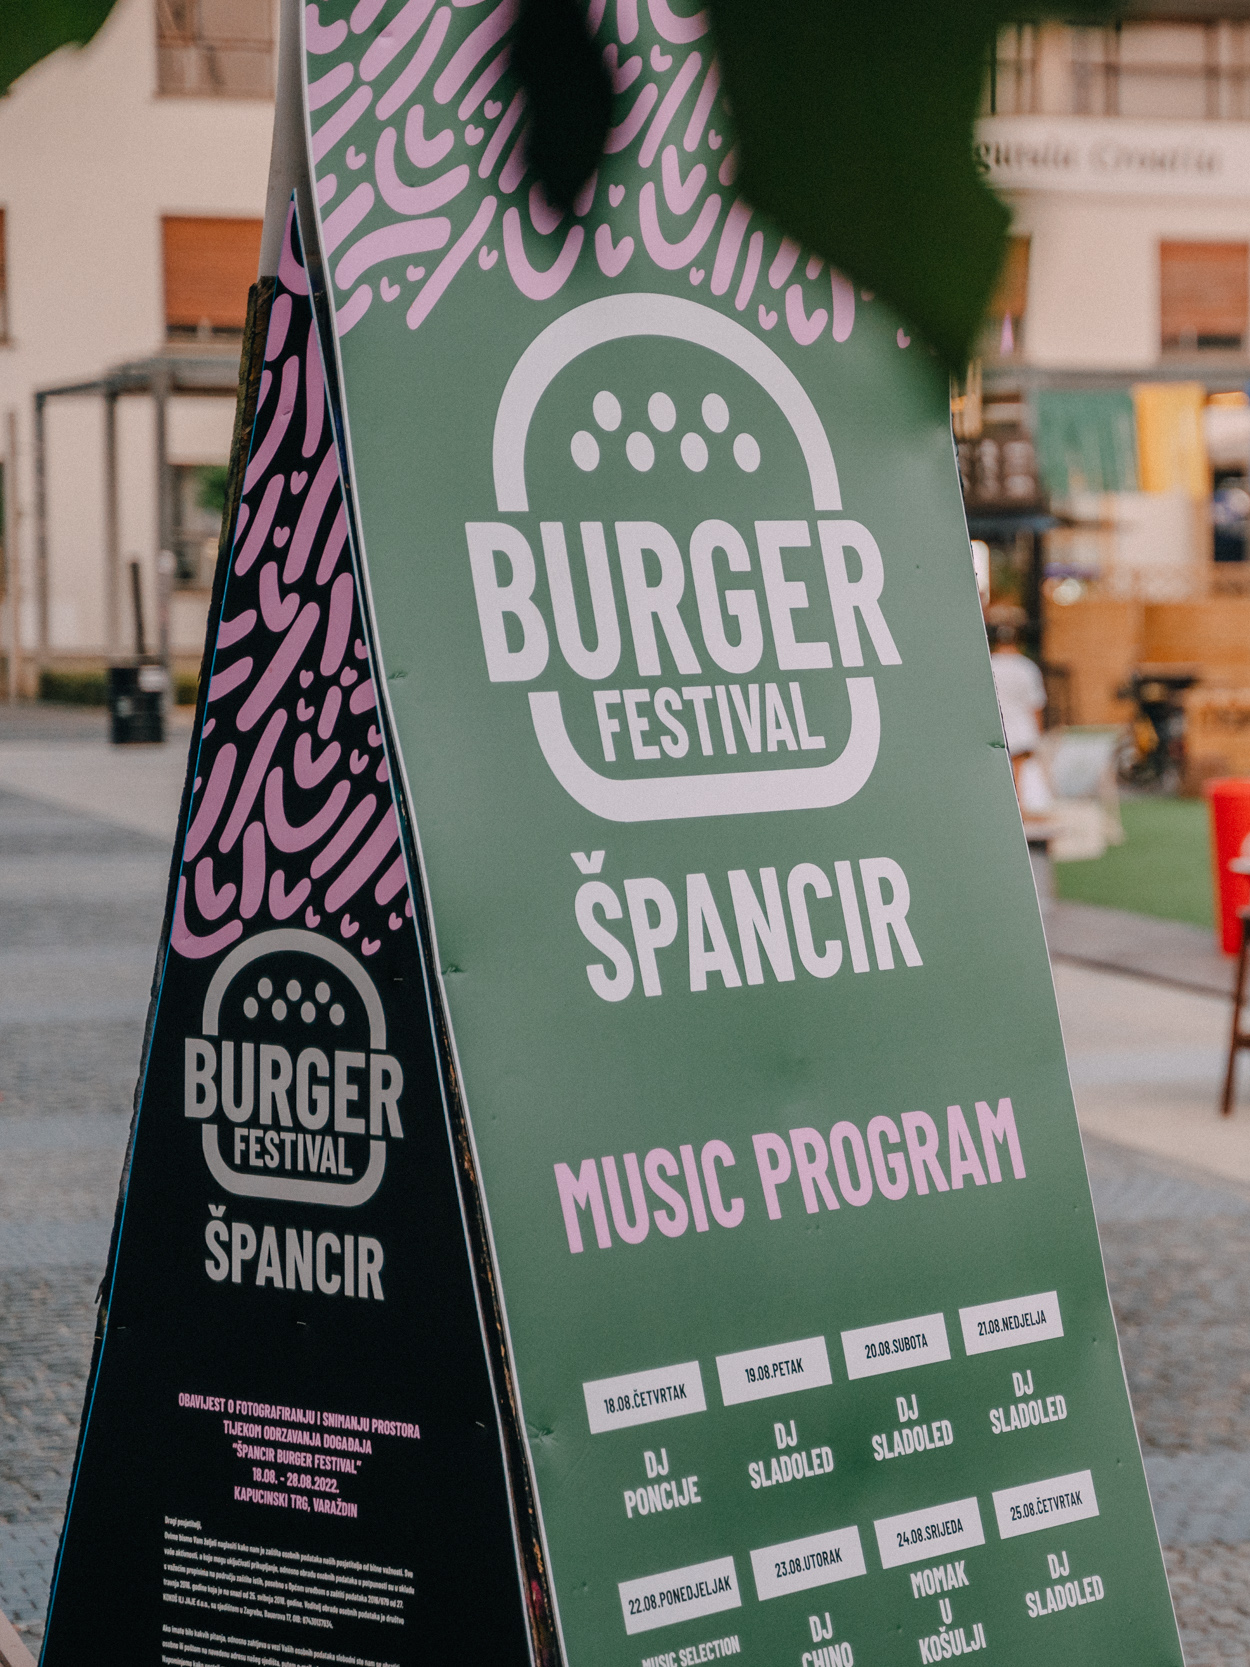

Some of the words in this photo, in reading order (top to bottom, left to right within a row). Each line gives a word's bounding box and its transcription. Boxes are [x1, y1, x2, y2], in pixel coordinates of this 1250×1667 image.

[465, 518, 903, 682] BURGER
[593, 681, 827, 762] FESTIVAL
[570, 850, 924, 1002] ŠPANCIR
[184, 1037, 404, 1138] BURGER
[234, 1126, 353, 1176] FESTIVAL
[553, 1139, 746, 1254] MUSIC
[751, 1096, 1027, 1221] PROGRAM
[204, 1203, 385, 1300] ŠPANCIR
[977, 1310, 1047, 1337] 21.08.NEDJELJA
[864, 1333, 929, 1359] 20.08.SUBOTA
[744, 1357, 804, 1383] 19.08.PETAK
[1011, 1369, 1034, 1398] DJ
[603, 1383, 687, 1414] 18.08.ČETVRTAK
[895, 1393, 919, 1423] DJ
[989, 1394, 1068, 1435] SLADOLED
[178, 1392, 226, 1413] OBAVIJEST
[227, 1399, 234, 1414] O
[236, 1400, 315, 1425] FOTOGRAFIRANJU
[317, 1411, 321, 1425] I
[322, 1411, 370, 1432] SNIMANJU
[371, 1418, 420, 1439] PROSTORA
[223, 1420, 262, 1439] TIJEKOM
[773, 1419, 798, 1450] DJ
[871, 1419, 954, 1461] SLADOLED
[276, 1448, 312, 1468] BURGER
[643, 1447, 669, 1479] DJ
[748, 1446, 834, 1490] SLADOLED
[252, 1466, 278, 1484] 18.08.
[286, 1472, 339, 1493] 28.08.2022.
[234, 1485, 288, 1508] KAPUCINSKI
[290, 1493, 311, 1512] TRG,
[312, 1497, 358, 1518] VARAŽDIN
[623, 1476, 702, 1519] PONCIJE
[1010, 1491, 1083, 1521] 25.08.ČETVRTAK
[896, 1518, 964, 1548] 24.08.SRIJEDA
[774, 1547, 843, 1578] 23.08.UTORAK
[1046, 1550, 1070, 1580] DJ
[628, 1575, 732, 1615] 22.08.PONEDJELJAK
[909, 1559, 970, 1599] MOMAK
[938, 1597, 953, 1625] U
[1025, 1574, 1105, 1618] SLADOLED
[808, 1611, 834, 1643] DJ
[678, 1634, 741, 1667] SELECTION
[801, 1641, 854, 1667] CHINO
[918, 1622, 987, 1665] KOŠULJI
